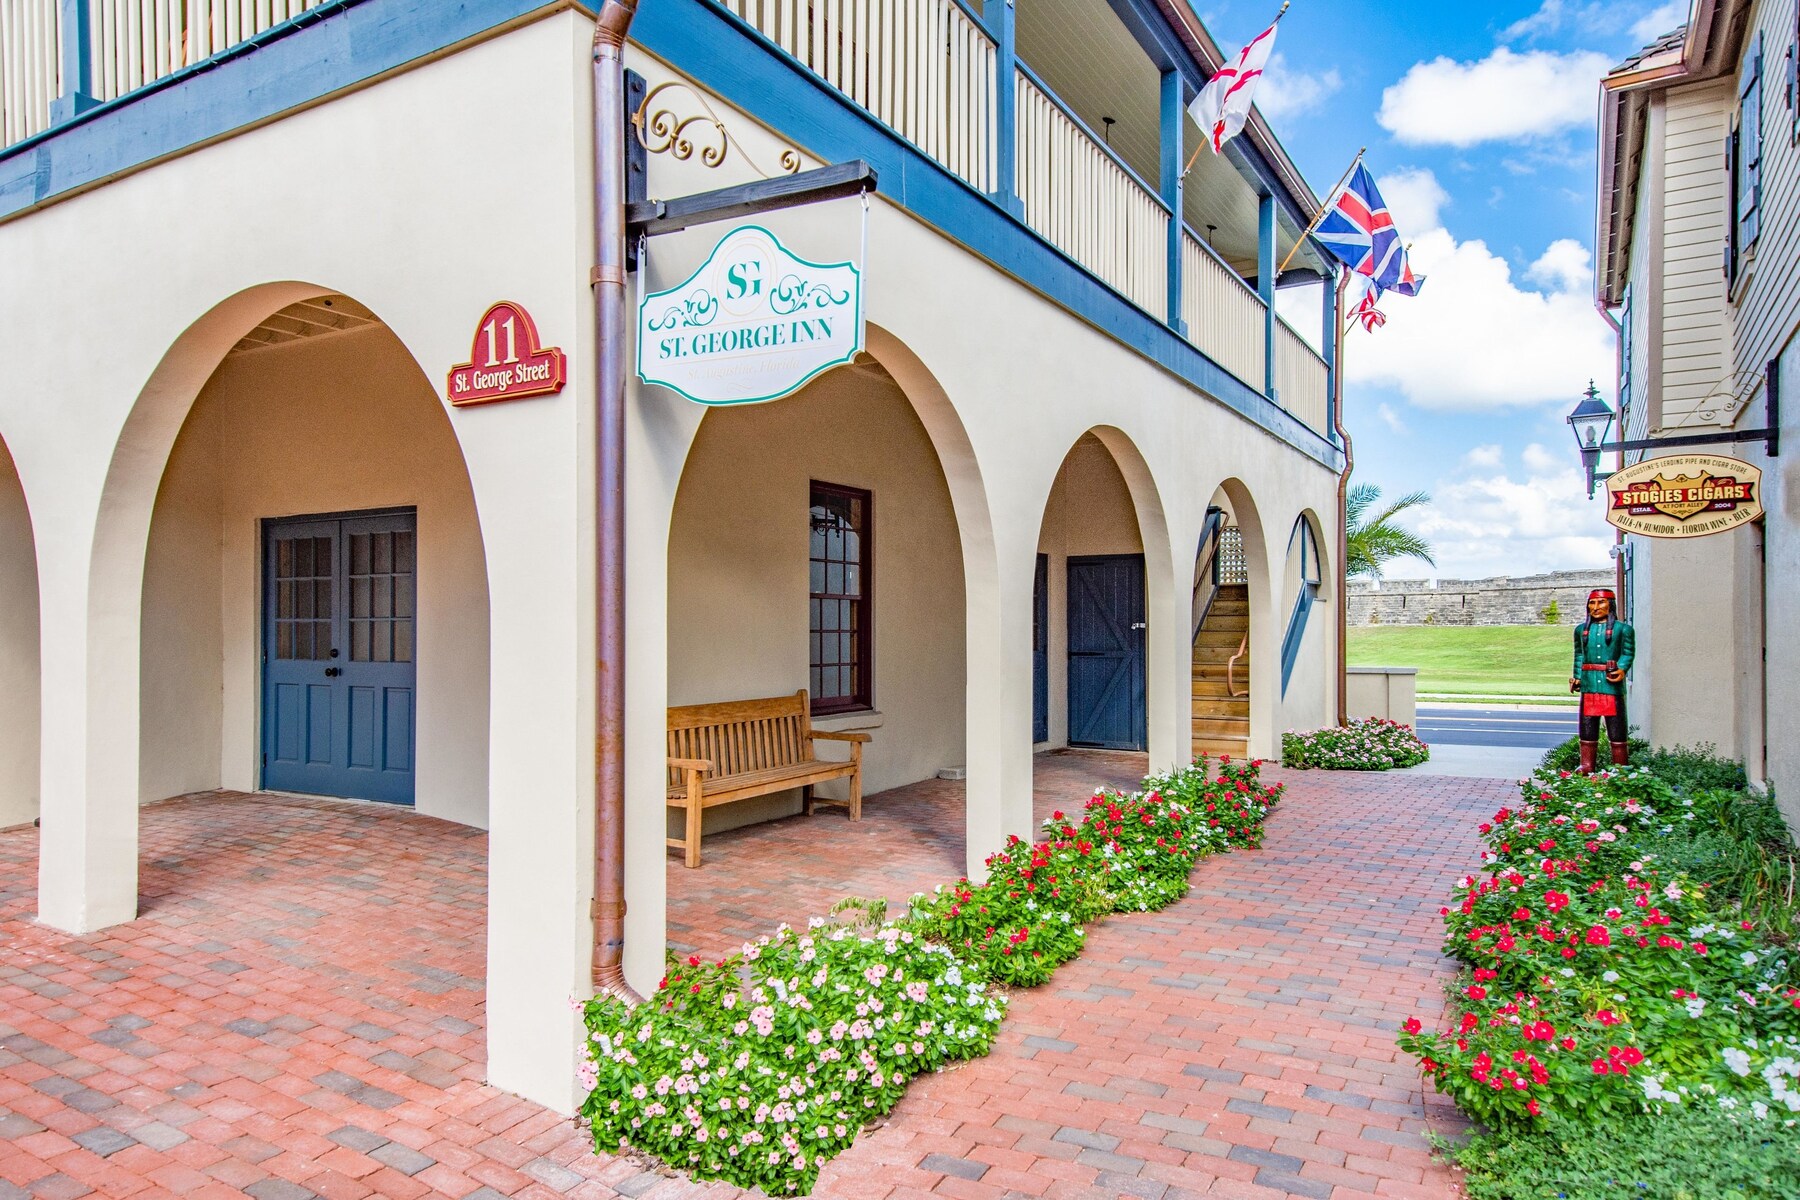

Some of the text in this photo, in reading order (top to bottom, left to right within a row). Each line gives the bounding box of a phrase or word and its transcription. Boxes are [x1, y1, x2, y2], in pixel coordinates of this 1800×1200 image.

[483, 315, 520, 367] 11
[659, 316, 833, 360] ST. GEORGE INN
[455, 359, 550, 393] St. George Street
[759, 356, 799, 373] Florida
[1625, 462, 1659, 478] AUGUSTINE'S
[1660, 459, 1683, 468] LEADING
[1712, 459, 1729, 468] CIGAR
[1730, 463, 1748, 474] STORE
[1622, 485, 1745, 505] STOGIES CIGARS
[1617, 508, 1751, 534] WALK-IN HUMIDOR FLORIDA WINE BEER
